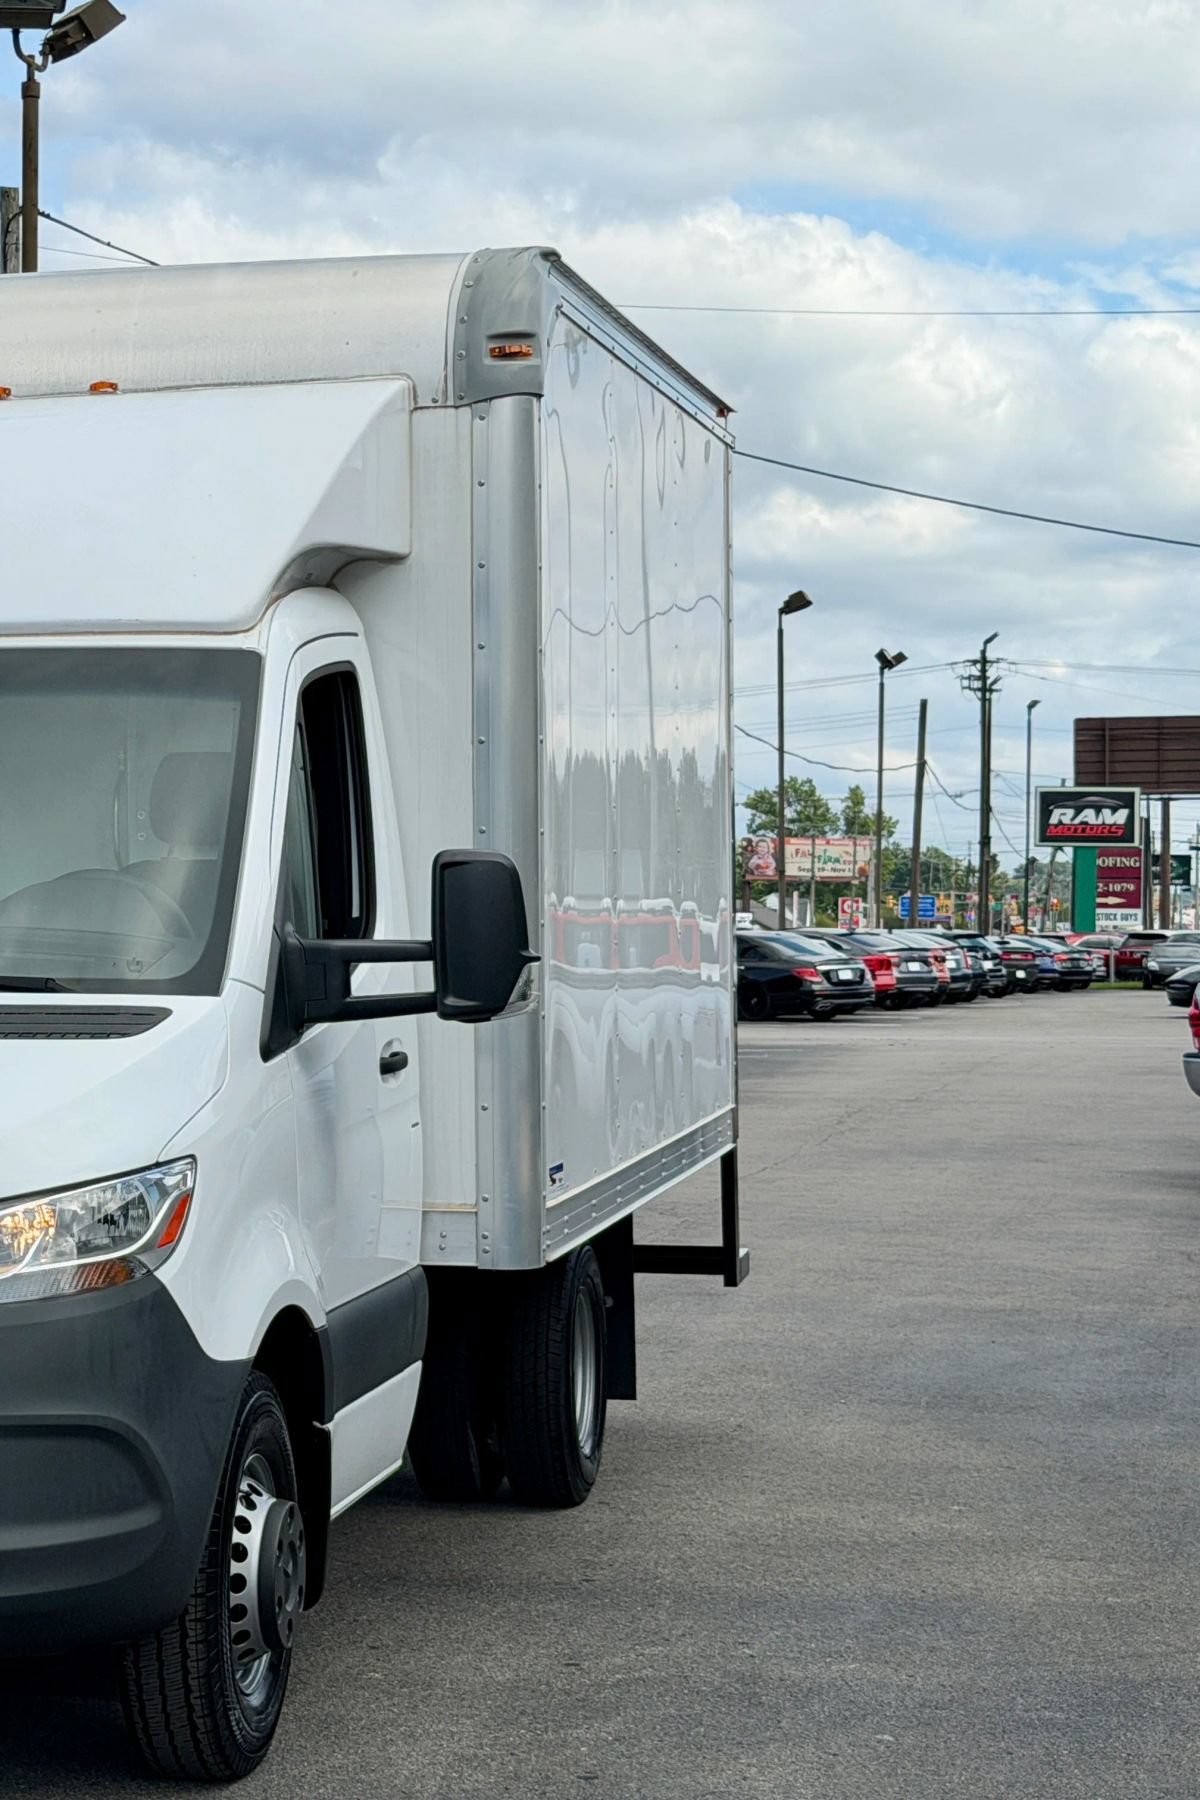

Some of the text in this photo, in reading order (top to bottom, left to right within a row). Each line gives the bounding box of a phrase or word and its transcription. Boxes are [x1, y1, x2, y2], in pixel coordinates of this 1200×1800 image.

[1048, 808, 1130, 825] RAM
[1046, 825, 1126, 837] MOTORS
[1096, 856, 1140, 868] OFING
